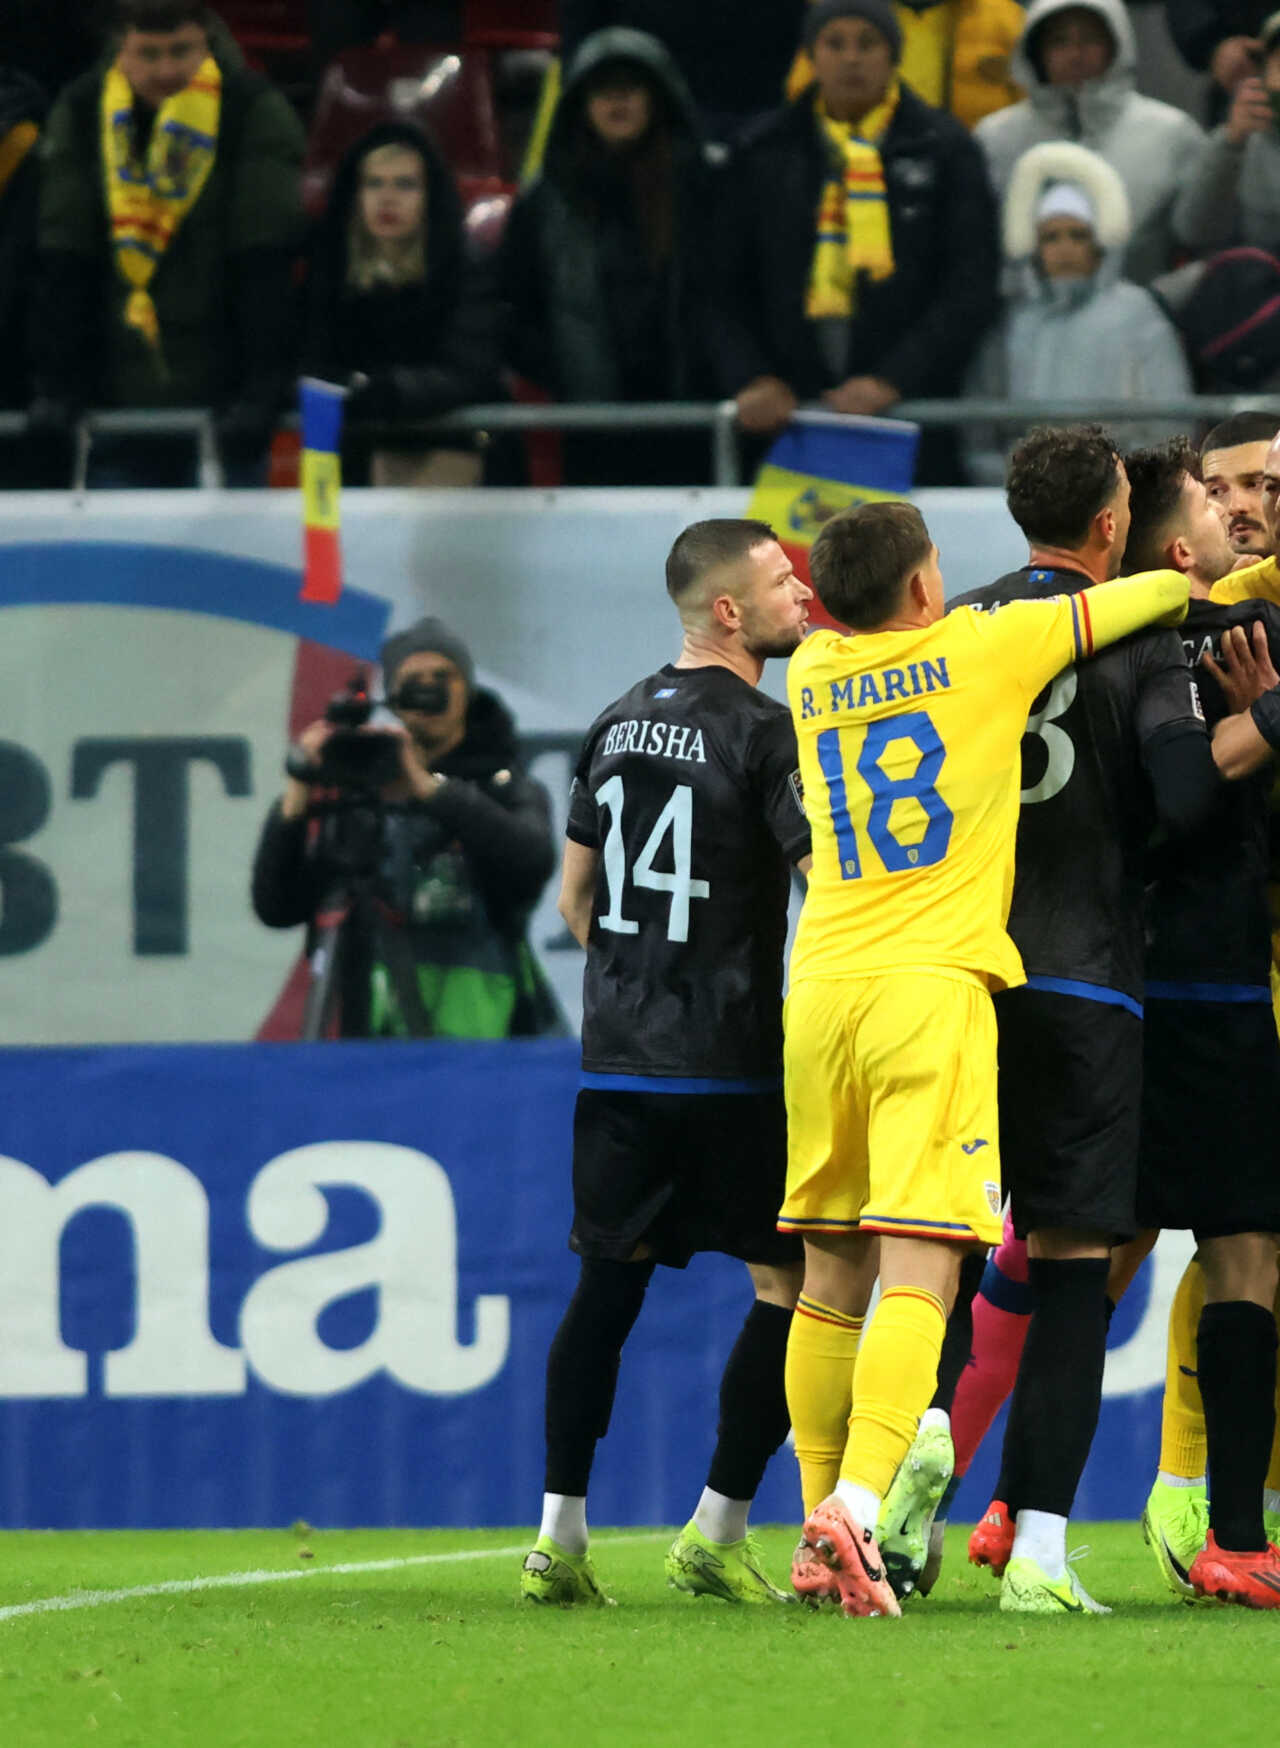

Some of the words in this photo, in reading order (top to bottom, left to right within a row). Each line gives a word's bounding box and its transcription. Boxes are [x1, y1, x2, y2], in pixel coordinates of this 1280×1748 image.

[603, 719, 706, 763] BERISHA
[801, 688, 823, 719] R.
[830, 657, 952, 713] MARIN
[816, 711, 954, 880] 18
[594, 775, 710, 943] 14
